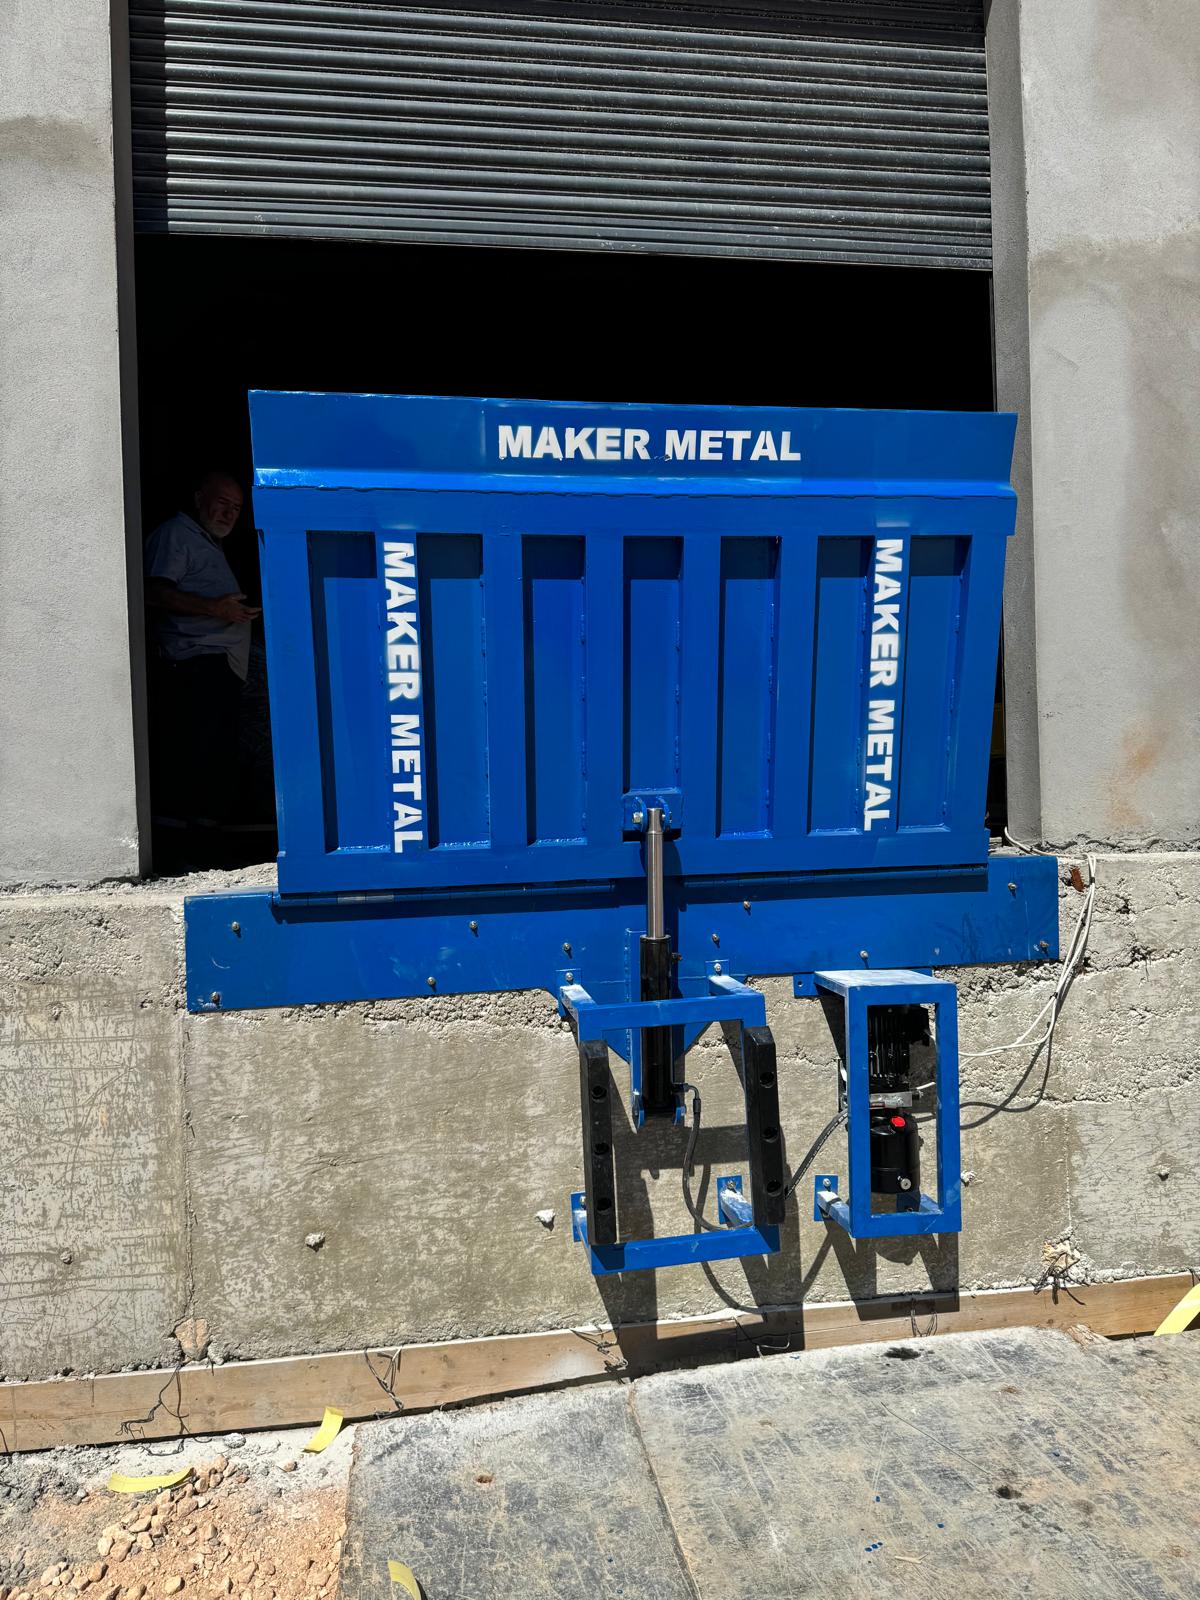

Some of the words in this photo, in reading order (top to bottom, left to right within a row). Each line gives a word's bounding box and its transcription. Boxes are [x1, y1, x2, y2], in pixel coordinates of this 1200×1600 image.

[498, 425, 651, 460] MAKER
[665, 430, 801, 461] METAL
[383, 542, 420, 701] MAKER
[869, 539, 903, 688] MAKER
[390, 714, 423, 853] METAL
[864, 699, 895, 831] METAL
